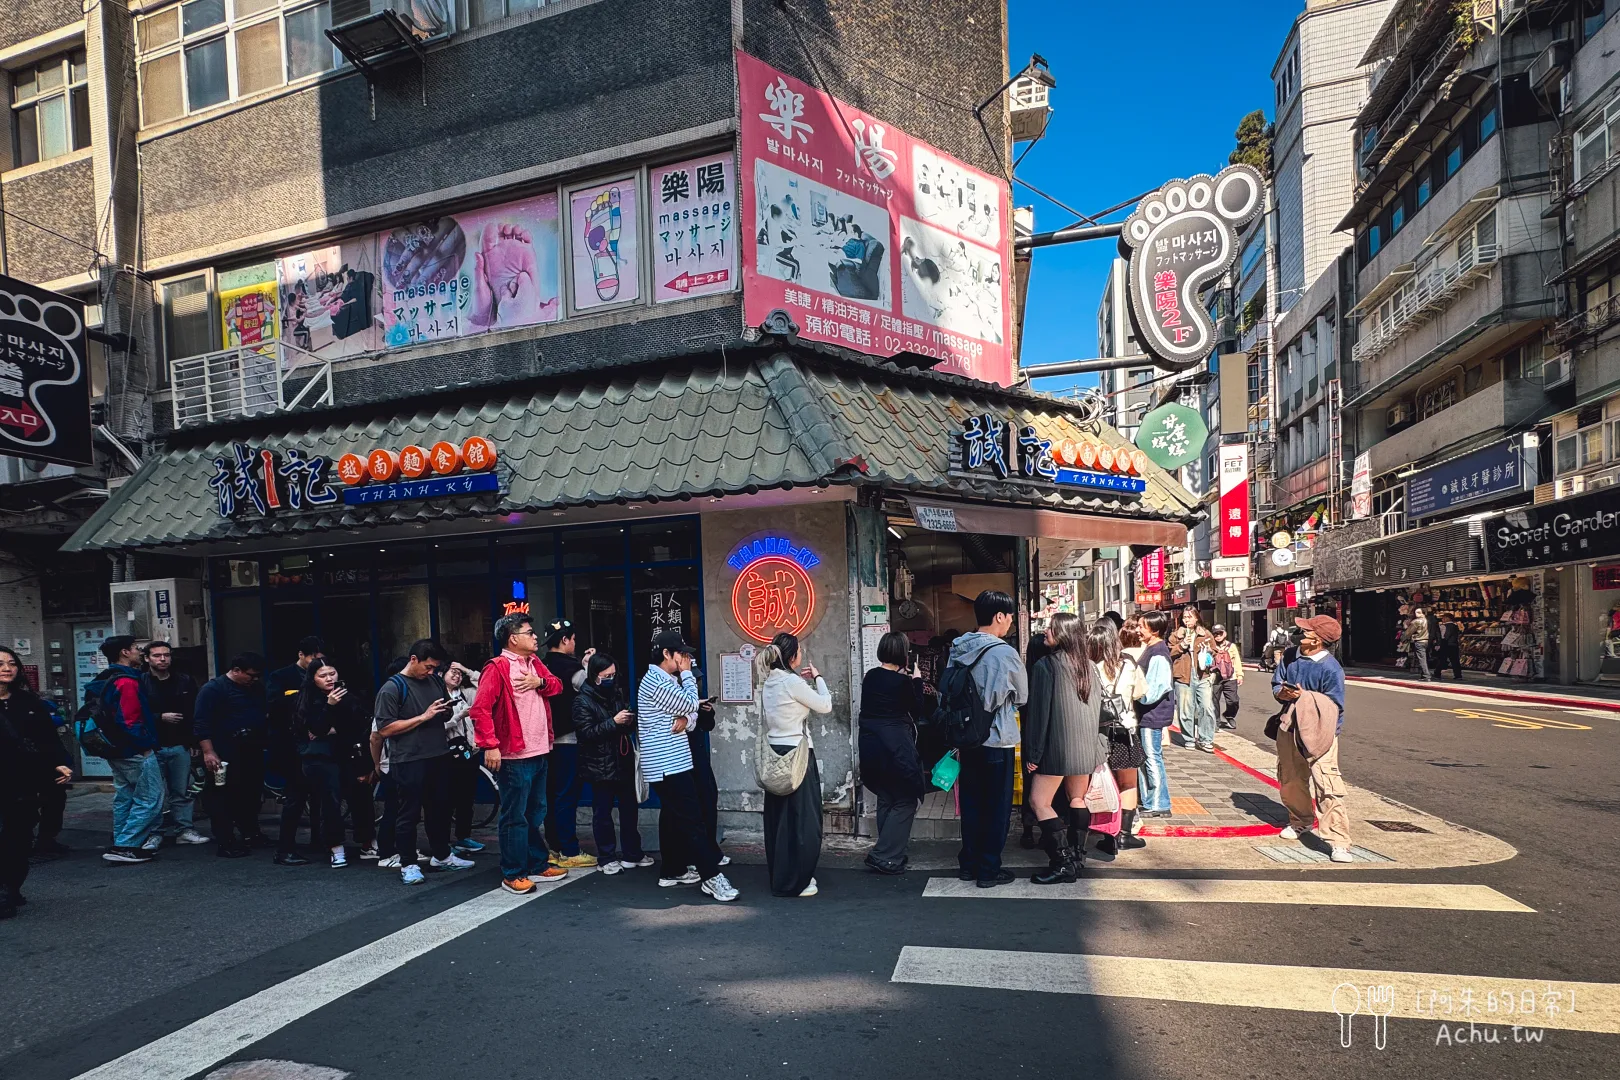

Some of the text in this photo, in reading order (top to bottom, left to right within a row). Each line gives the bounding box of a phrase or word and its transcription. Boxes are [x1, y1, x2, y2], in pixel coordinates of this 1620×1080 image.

[661, 162, 725, 203] 樂陽
[659, 201, 731, 224] massage
[659, 216, 731, 242] マッサージ
[665, 238, 725, 266] 마사지
[1155, 245, 1219, 267] フットマッサージ
[393, 276, 469, 301] massage
[392, 292, 469, 322] マッサージ
[408, 316, 458, 340] 마사지
[932, 329, 983, 358] massage
[0, 409, 38, 426] 入口
[342, 443, 485, 479] 越南麵食館
[1224, 460, 1242, 468] FET
[1449, 460, 1515, 494] 誠良牙醫診所
[1228, 507, 1242, 538] 遠傳
[1497, 522, 1550, 548] Secret
[746, 570, 800, 629] 誠
